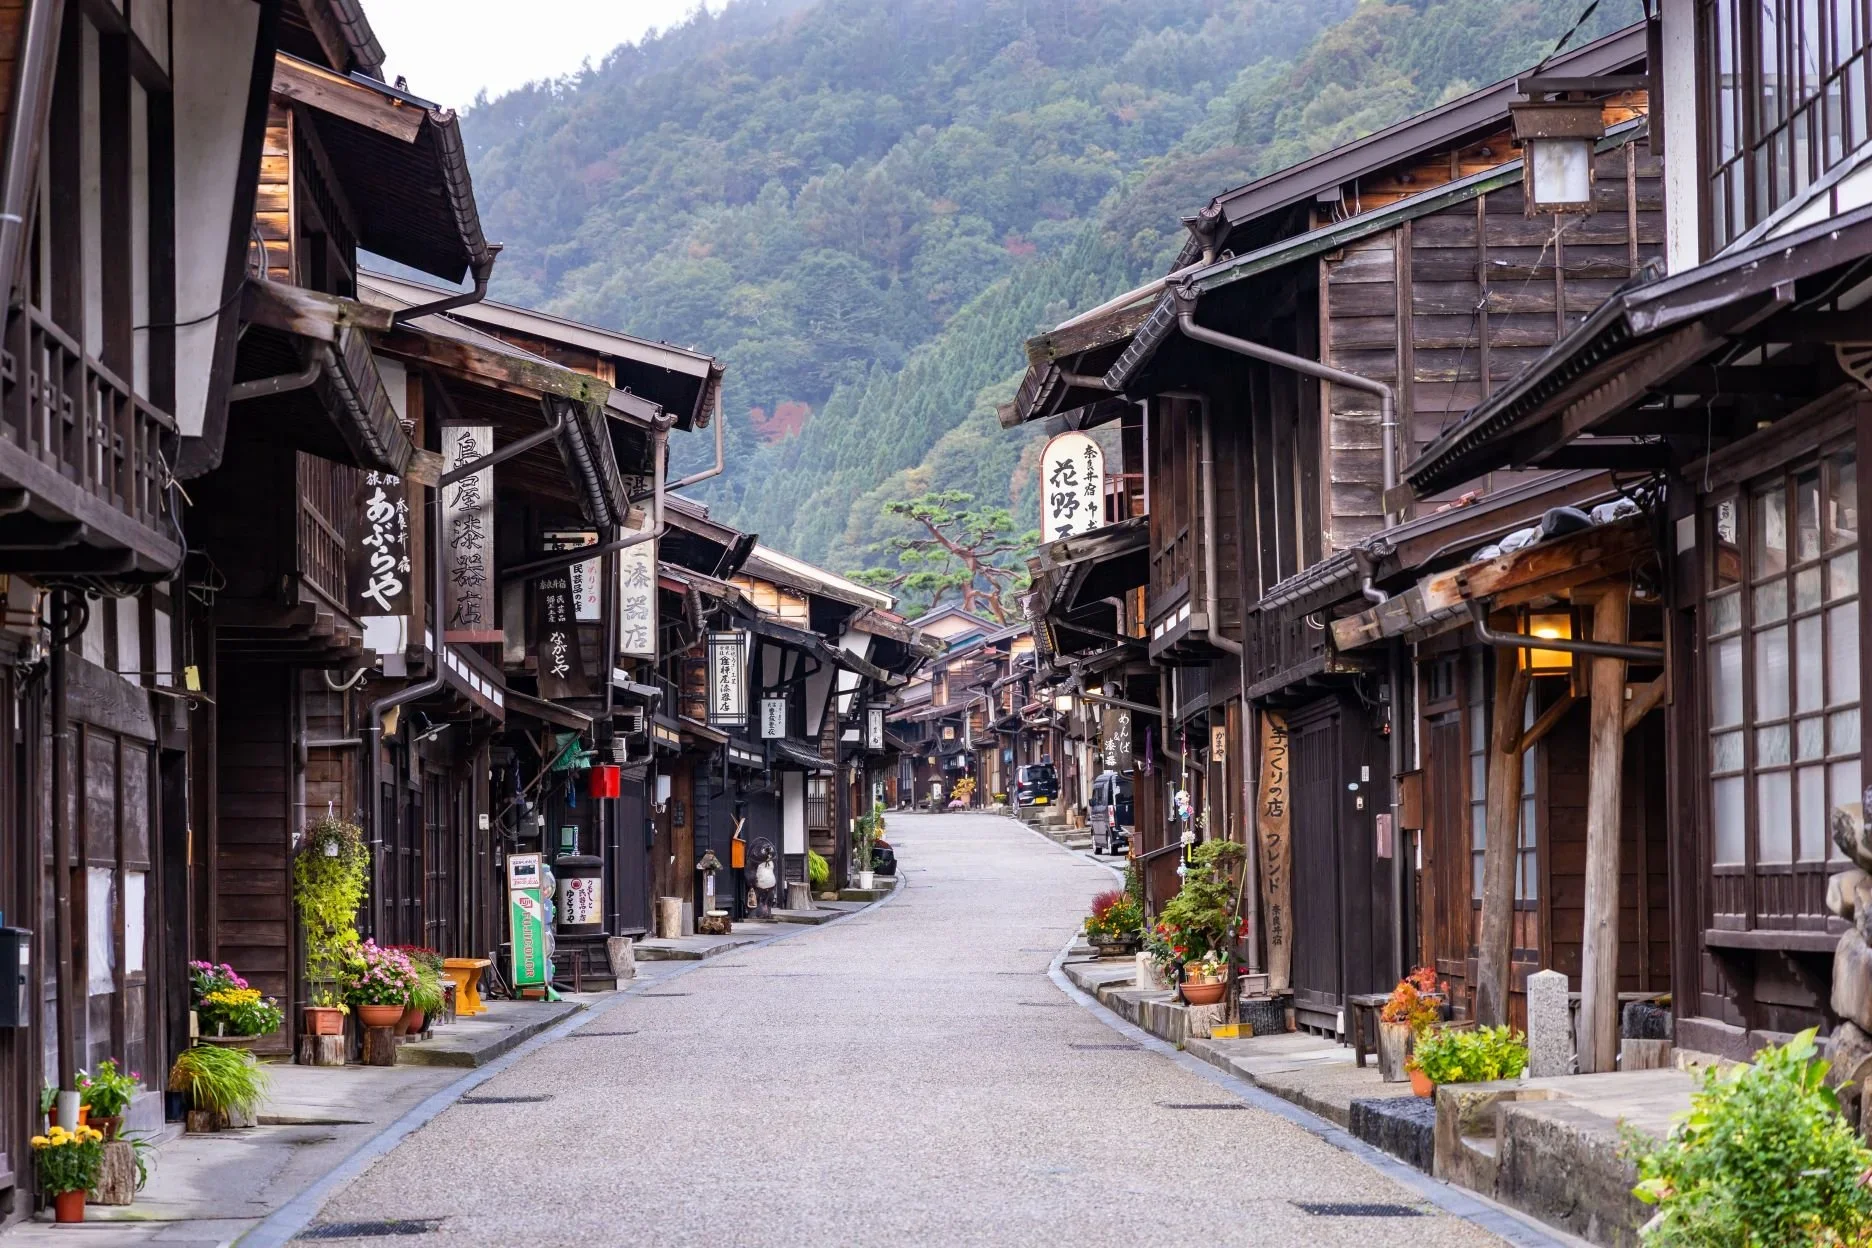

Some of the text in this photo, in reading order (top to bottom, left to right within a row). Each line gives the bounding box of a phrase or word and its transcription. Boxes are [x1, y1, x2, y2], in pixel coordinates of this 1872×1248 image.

[366, 470, 400, 486] 旅館
[1083, 444, 1099, 497] 奈良井宿
[361, 486, 403, 612] あぶらや
[396, 497, 411, 573] 奈良井宿
[540, 578, 567, 589] 奈良井宿
[550, 631, 570, 679] ながとや
[1264, 727, 1287, 947] 手づくりの店 フレンド 奈良井宿
[522, 911, 535, 978] FUJICOLOR
